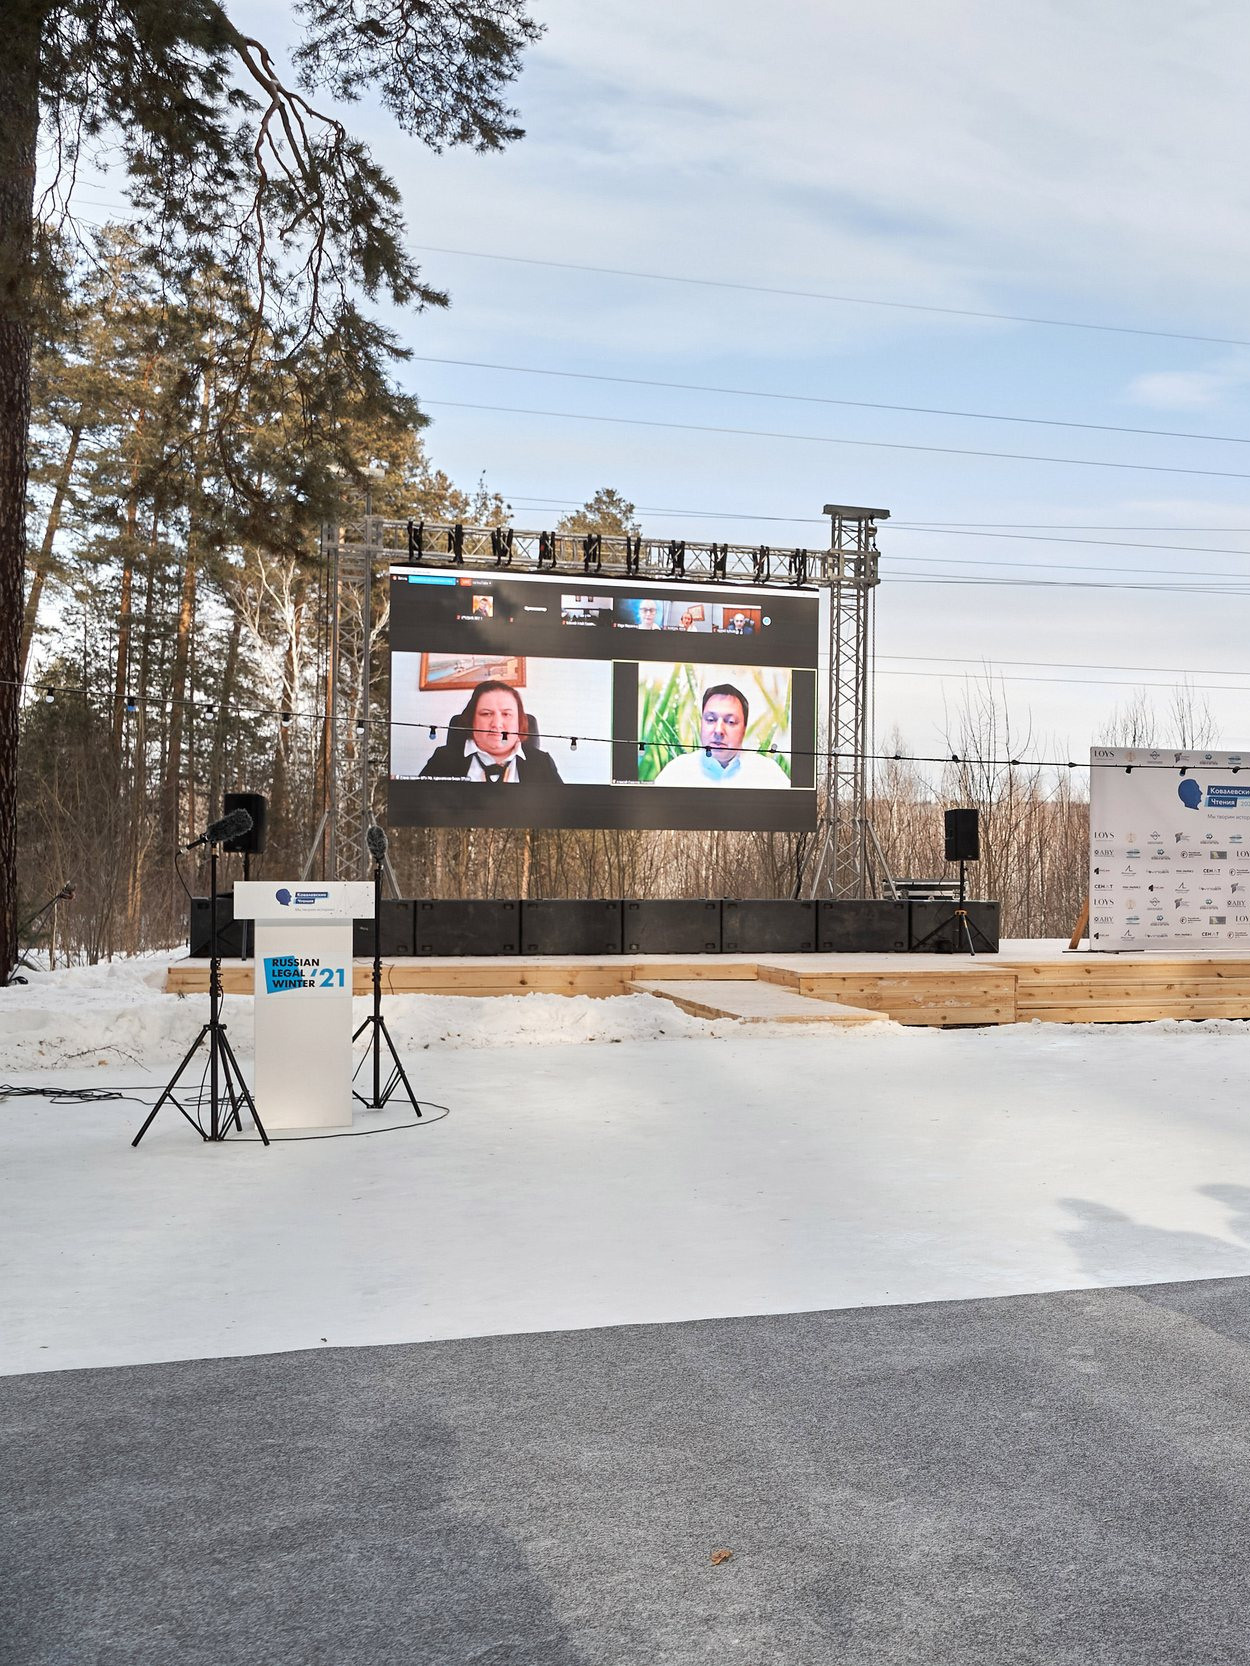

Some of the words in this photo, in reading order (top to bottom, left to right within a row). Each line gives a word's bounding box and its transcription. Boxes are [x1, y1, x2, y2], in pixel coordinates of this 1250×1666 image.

[1211, 798, 1236, 806] Чтения
[271, 958, 320, 967] RUSSIAN
[271, 969, 306, 978] LEGAL
[272, 979, 316, 988] WINTER
